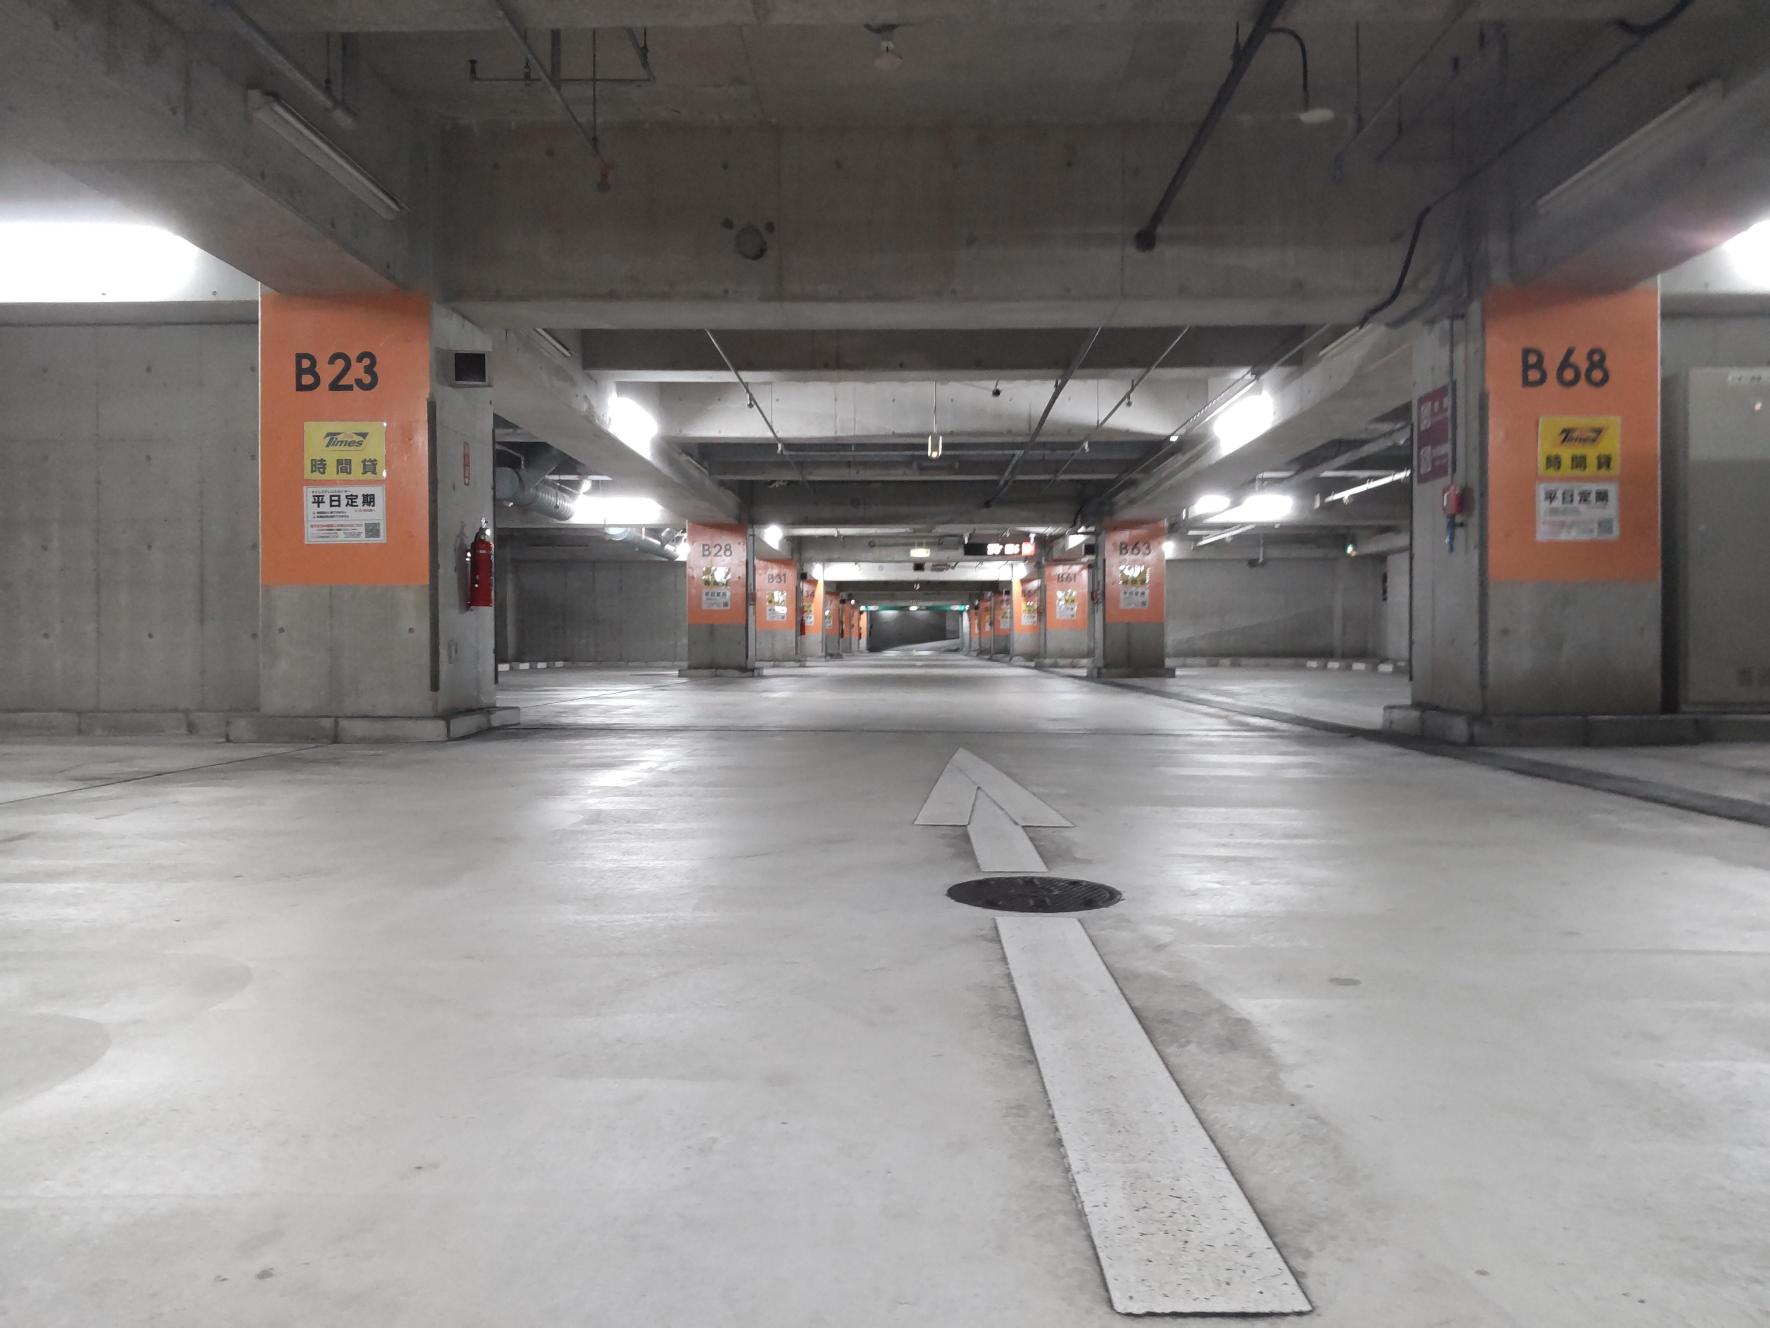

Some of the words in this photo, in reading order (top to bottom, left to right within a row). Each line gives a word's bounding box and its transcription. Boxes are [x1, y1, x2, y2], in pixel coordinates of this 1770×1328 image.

[295, 351, 379, 392] B23
[1521, 346, 1610, 389] B68
[323, 432, 369, 449] Times
[310, 458, 378, 475] 時間貸
[312, 493, 376, 508] 平日定期
[701, 543, 733, 558] B28
[1119, 541, 1152, 556] B63
